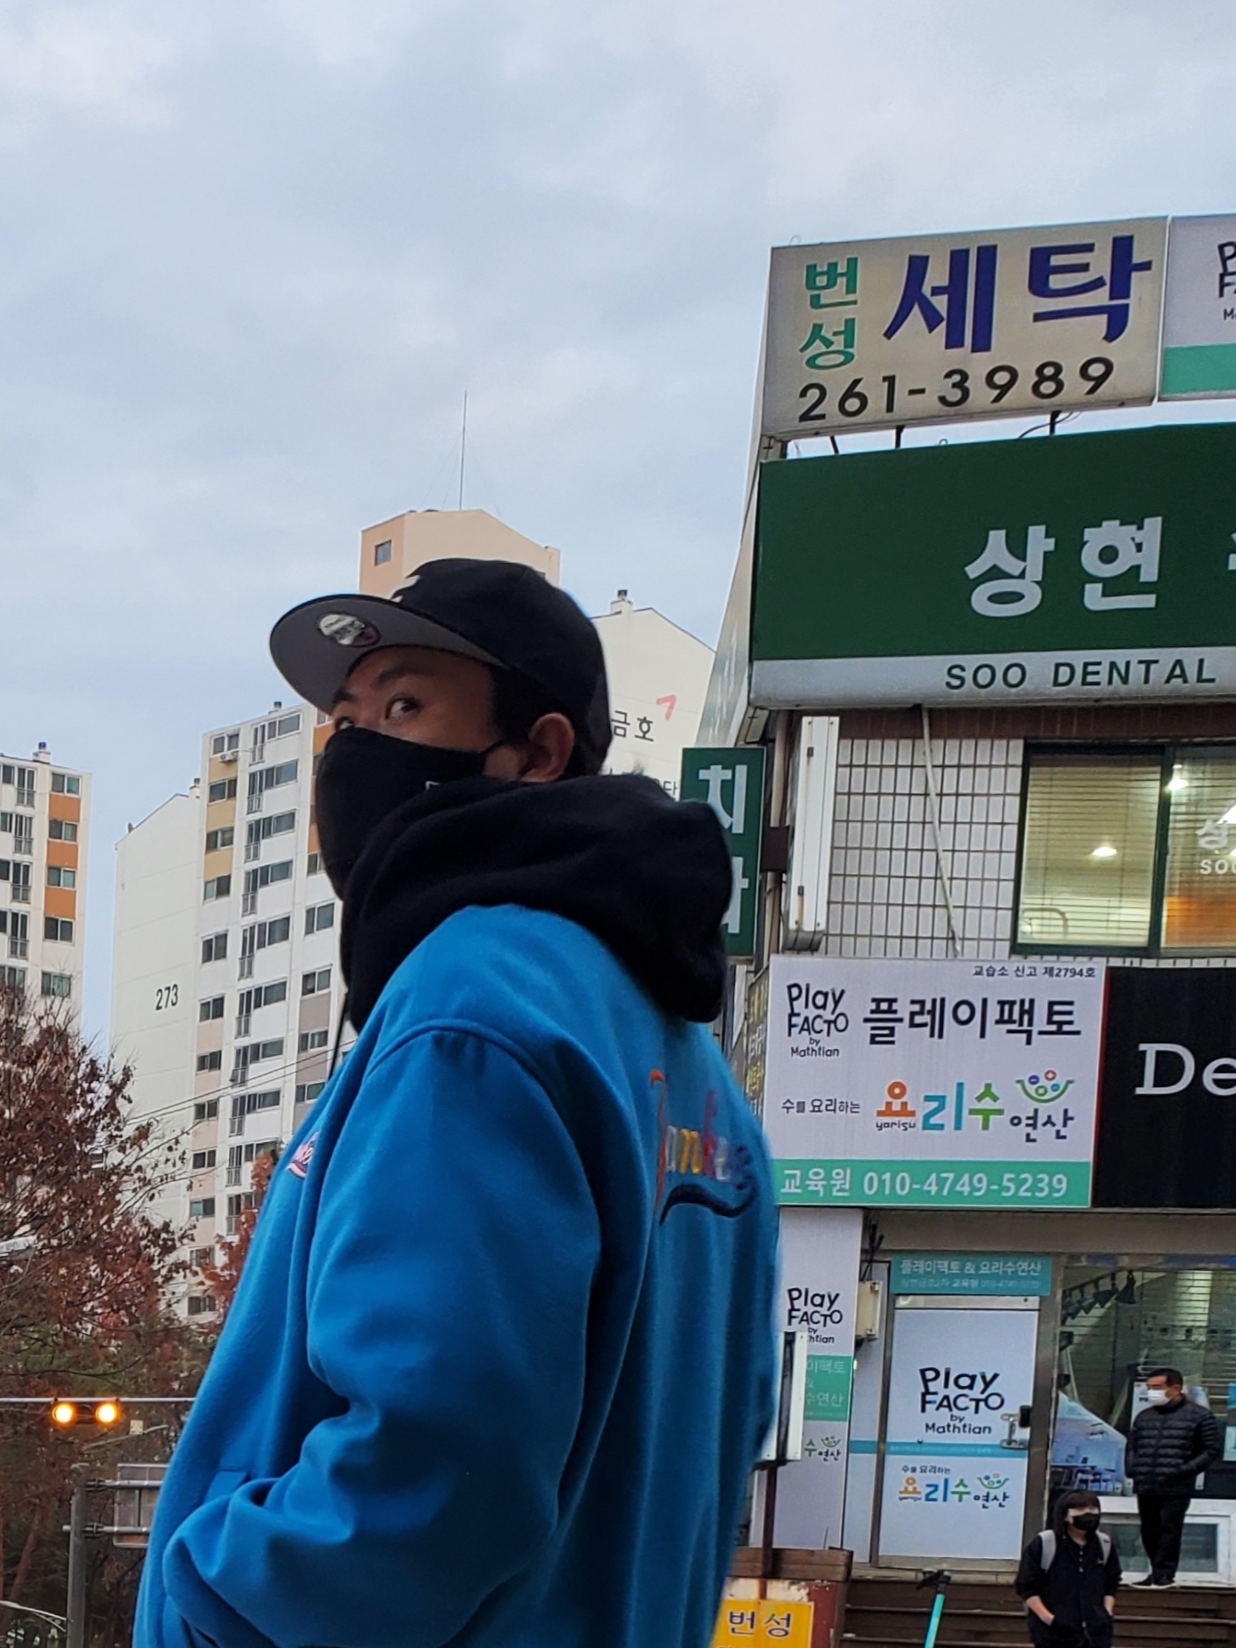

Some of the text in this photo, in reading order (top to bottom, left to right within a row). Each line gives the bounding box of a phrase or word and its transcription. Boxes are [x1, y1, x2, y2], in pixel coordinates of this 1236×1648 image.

[883, 235, 1153, 354] 세탁
[799, 256, 859, 371] 번성
[797, 356, 1115, 423] 261-3989
[964, 516, 1164, 618] 상현
[944, 657, 1218, 690] SOO DENTAL
[698, 764, 749, 935] 치
[972, 965, 1097, 979] 교습소 신고 제2794호
[155, 983, 179, 1011] 273
[786, 982, 846, 1016] Play
[787, 1012, 850, 1038] FACTO
[862, 996, 1082, 1046] 플레이팩토
[809, 1037, 821, 1047] by
[1134, 1043, 1236, 1097] De
[780, 1098, 861, 1115] 수를 요리하는
[780, 1167, 1068, 1198] 교육원 010-4749-5239
[900, 1259, 1042, 1277] 플레이팩토 & 요리수연산
[786, 1286, 841, 1312] Play
[786, 1308, 844, 1328] FACTO
[918, 1366, 1000, 1396] Play
[919, 1390, 1005, 1414] FACTO
[949, 1413, 966, 1424] by
[728, 1610, 792, 1638] 번성
